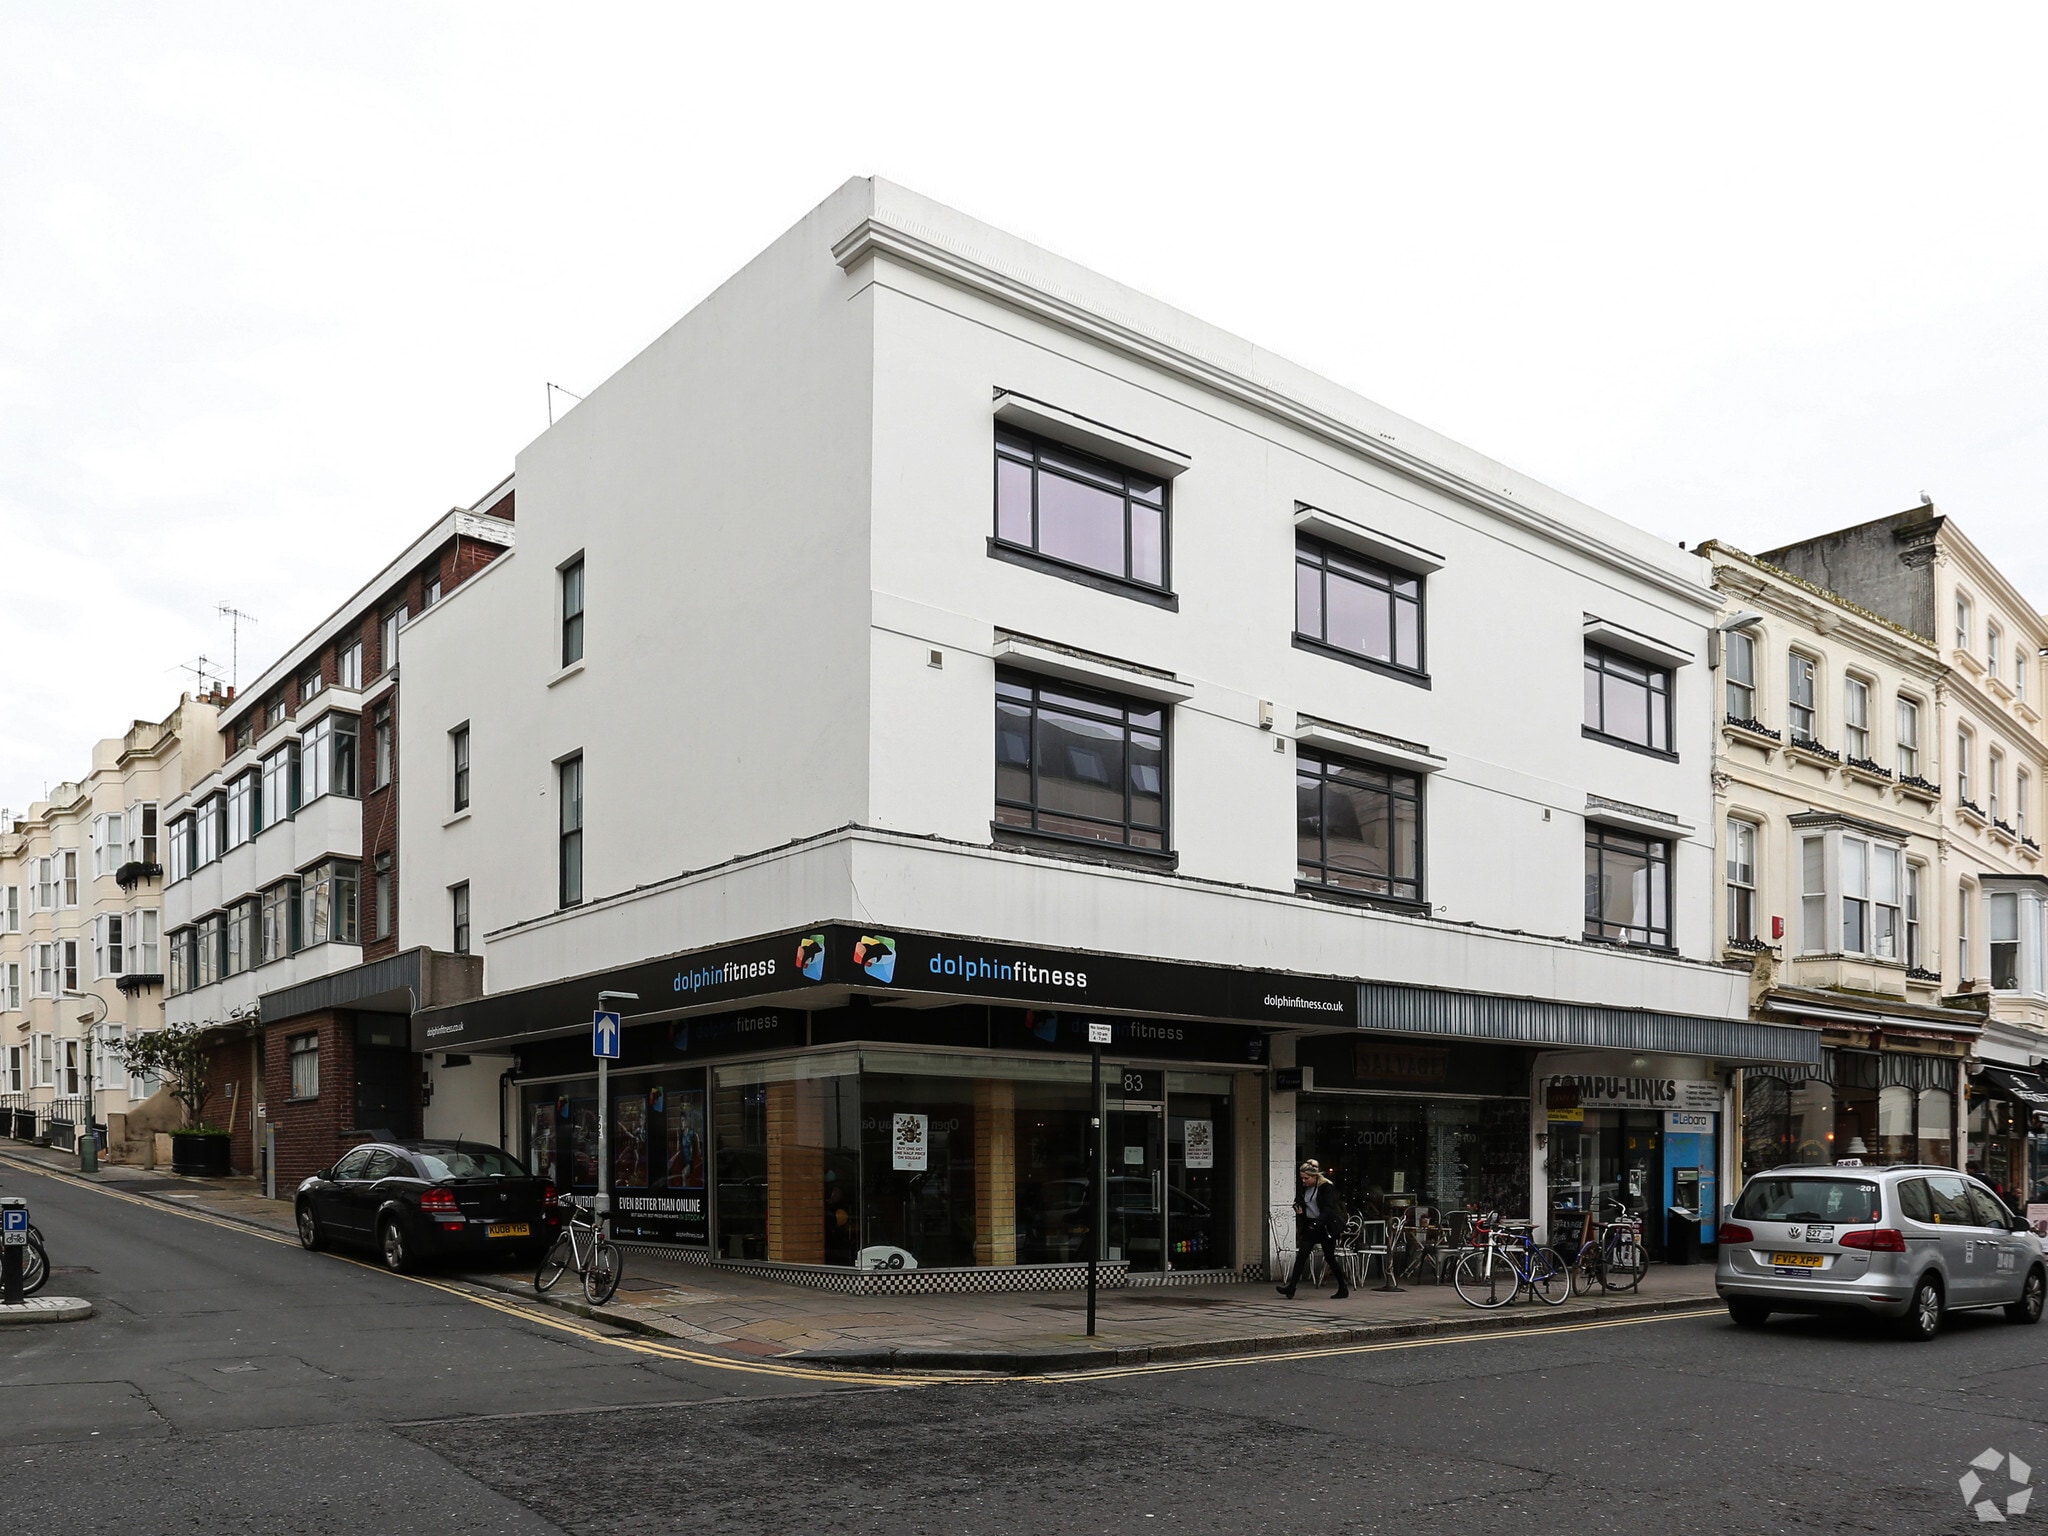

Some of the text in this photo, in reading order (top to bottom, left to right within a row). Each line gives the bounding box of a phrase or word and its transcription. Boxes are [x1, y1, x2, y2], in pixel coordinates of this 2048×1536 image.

[673, 959, 776, 992] dolphinfitness
[929, 953, 1088, 988] dolphinfitness
[1263, 994, 1344, 1012] dolphinfitness.co.uk
[1124, 1073, 1143, 1092] 83
[1550, 1074, 1676, 1104] COMPU-LINKS
[1680, 1112, 1706, 1125] Lebara
[619, 1197, 701, 1213] EVEN BETTER THAN ONLINE
[8, 1213, 22, 1229] P
[489, 1224, 527, 1234] KU08 YHS
[1807, 1229, 1821, 1237] 527
[1775, 1254, 1820, 1265] FV12 XPP
